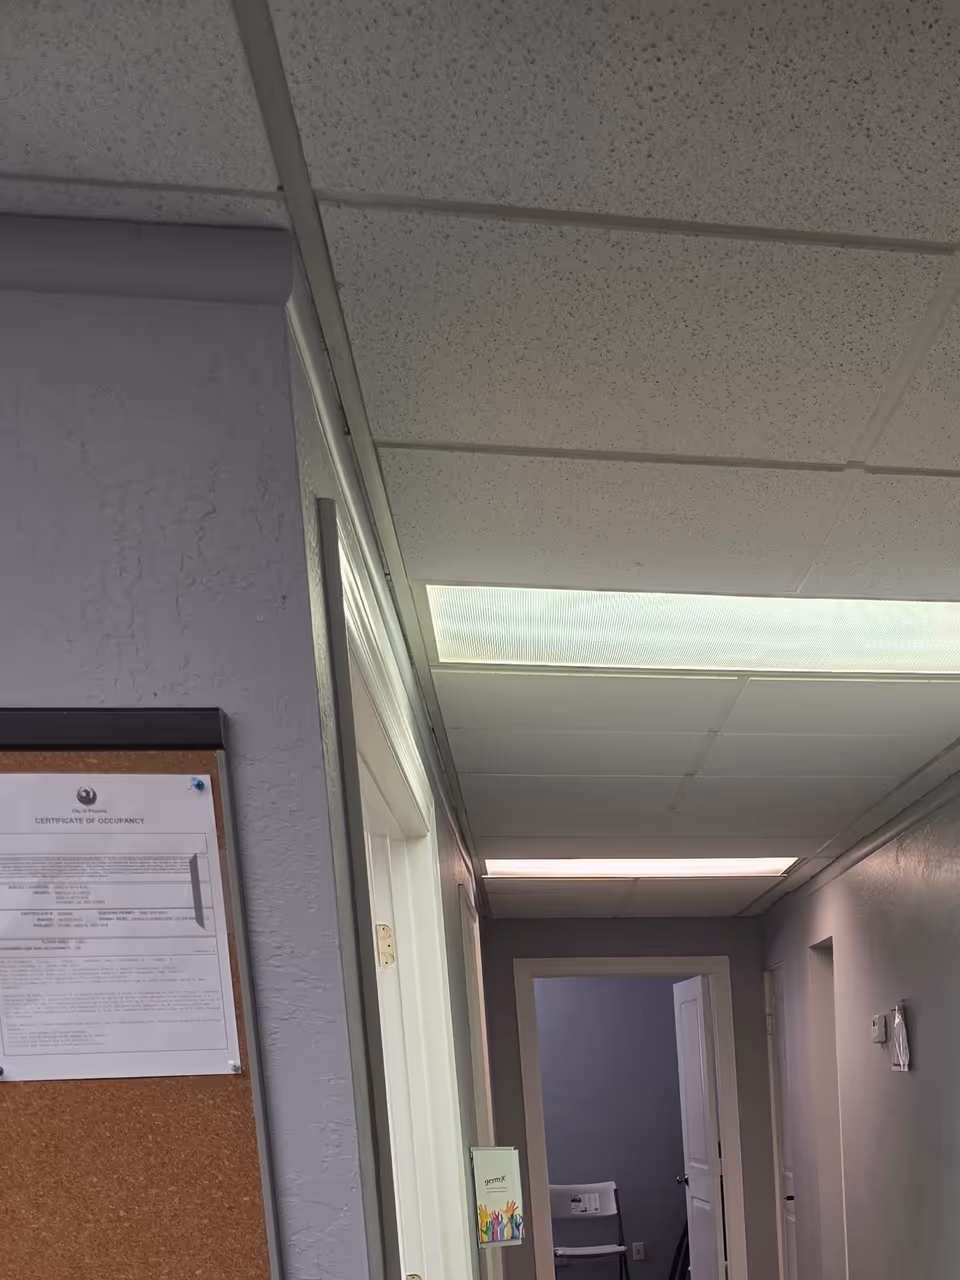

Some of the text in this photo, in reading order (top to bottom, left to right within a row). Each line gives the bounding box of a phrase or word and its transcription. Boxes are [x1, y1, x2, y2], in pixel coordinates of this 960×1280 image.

[34, 816, 145, 825] CERTIFICATE OF OCCUPANCY
